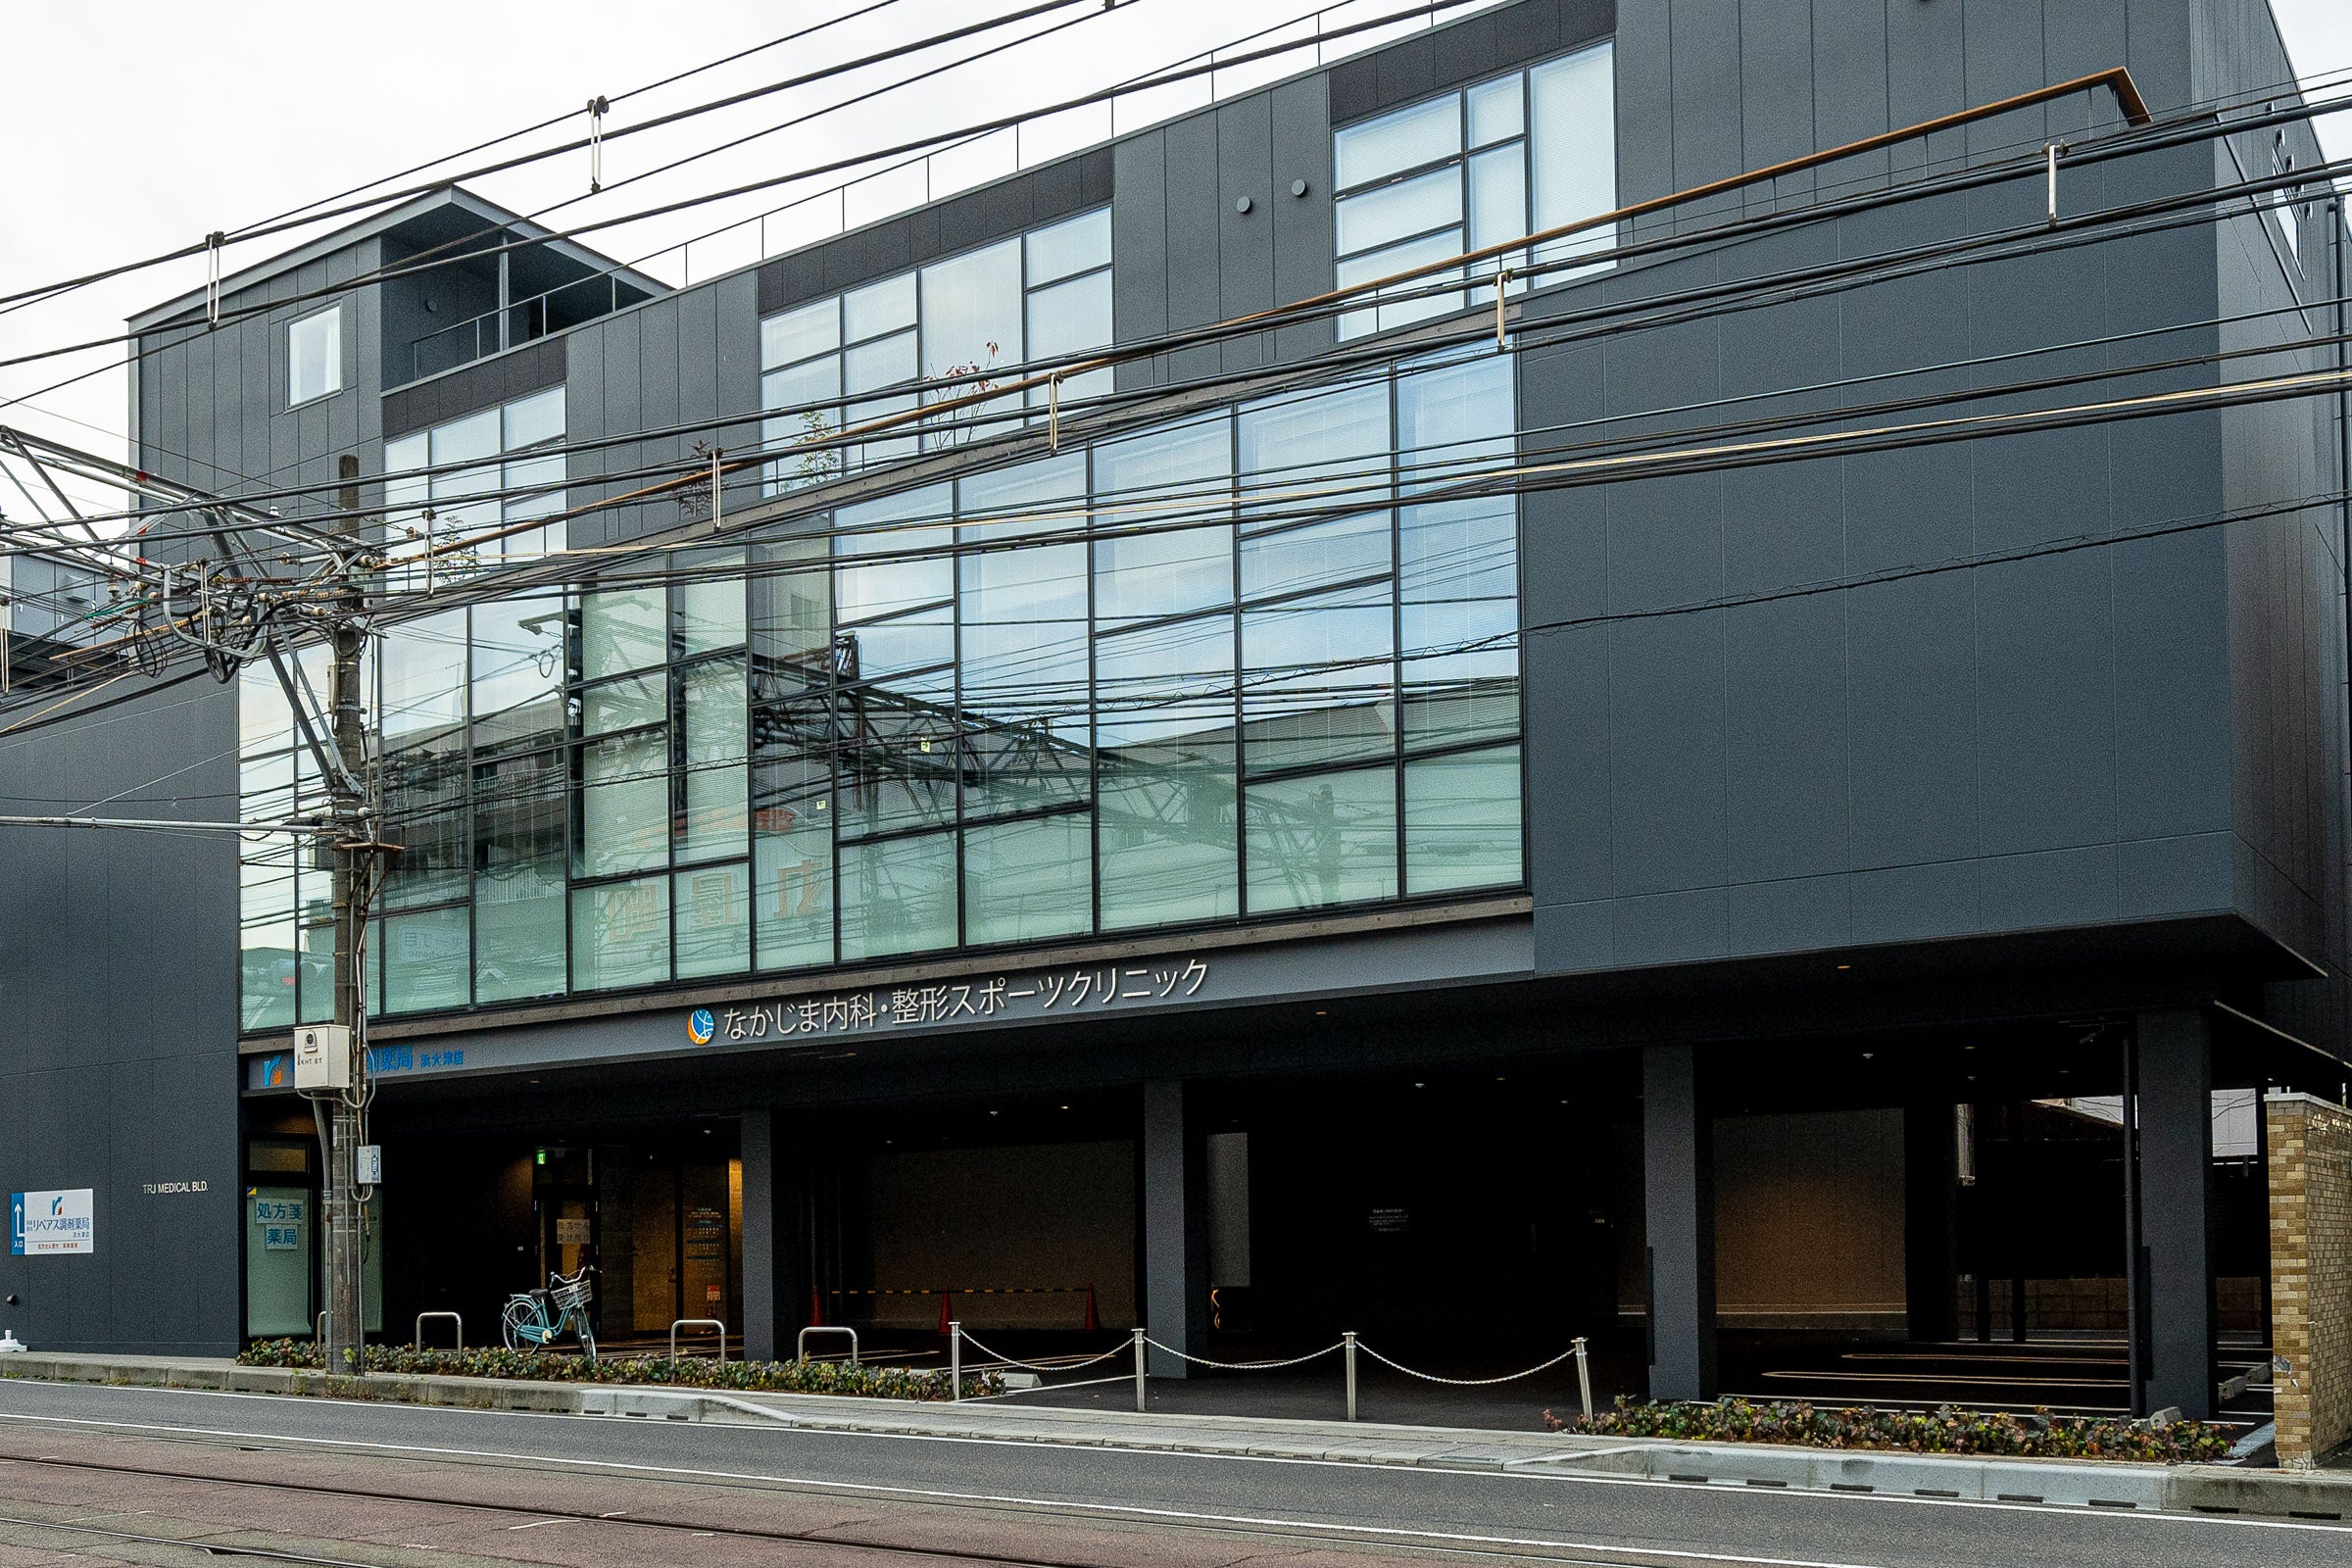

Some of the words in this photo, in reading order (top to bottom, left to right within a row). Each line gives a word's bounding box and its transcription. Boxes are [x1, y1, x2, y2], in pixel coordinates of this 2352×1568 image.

[723, 958, 1208, 1040] なかじま内科・整形スポーツクリニック
[142, 1184, 157, 1195] TRJ
[158, 1182, 190, 1194] MEDICAL
[192, 1180, 209, 1193] BLD.
[257, 1201, 304, 1220] 処方箋
[14, 1240, 24, 1249] 入口
[267, 1227, 297, 1245] 薬局
